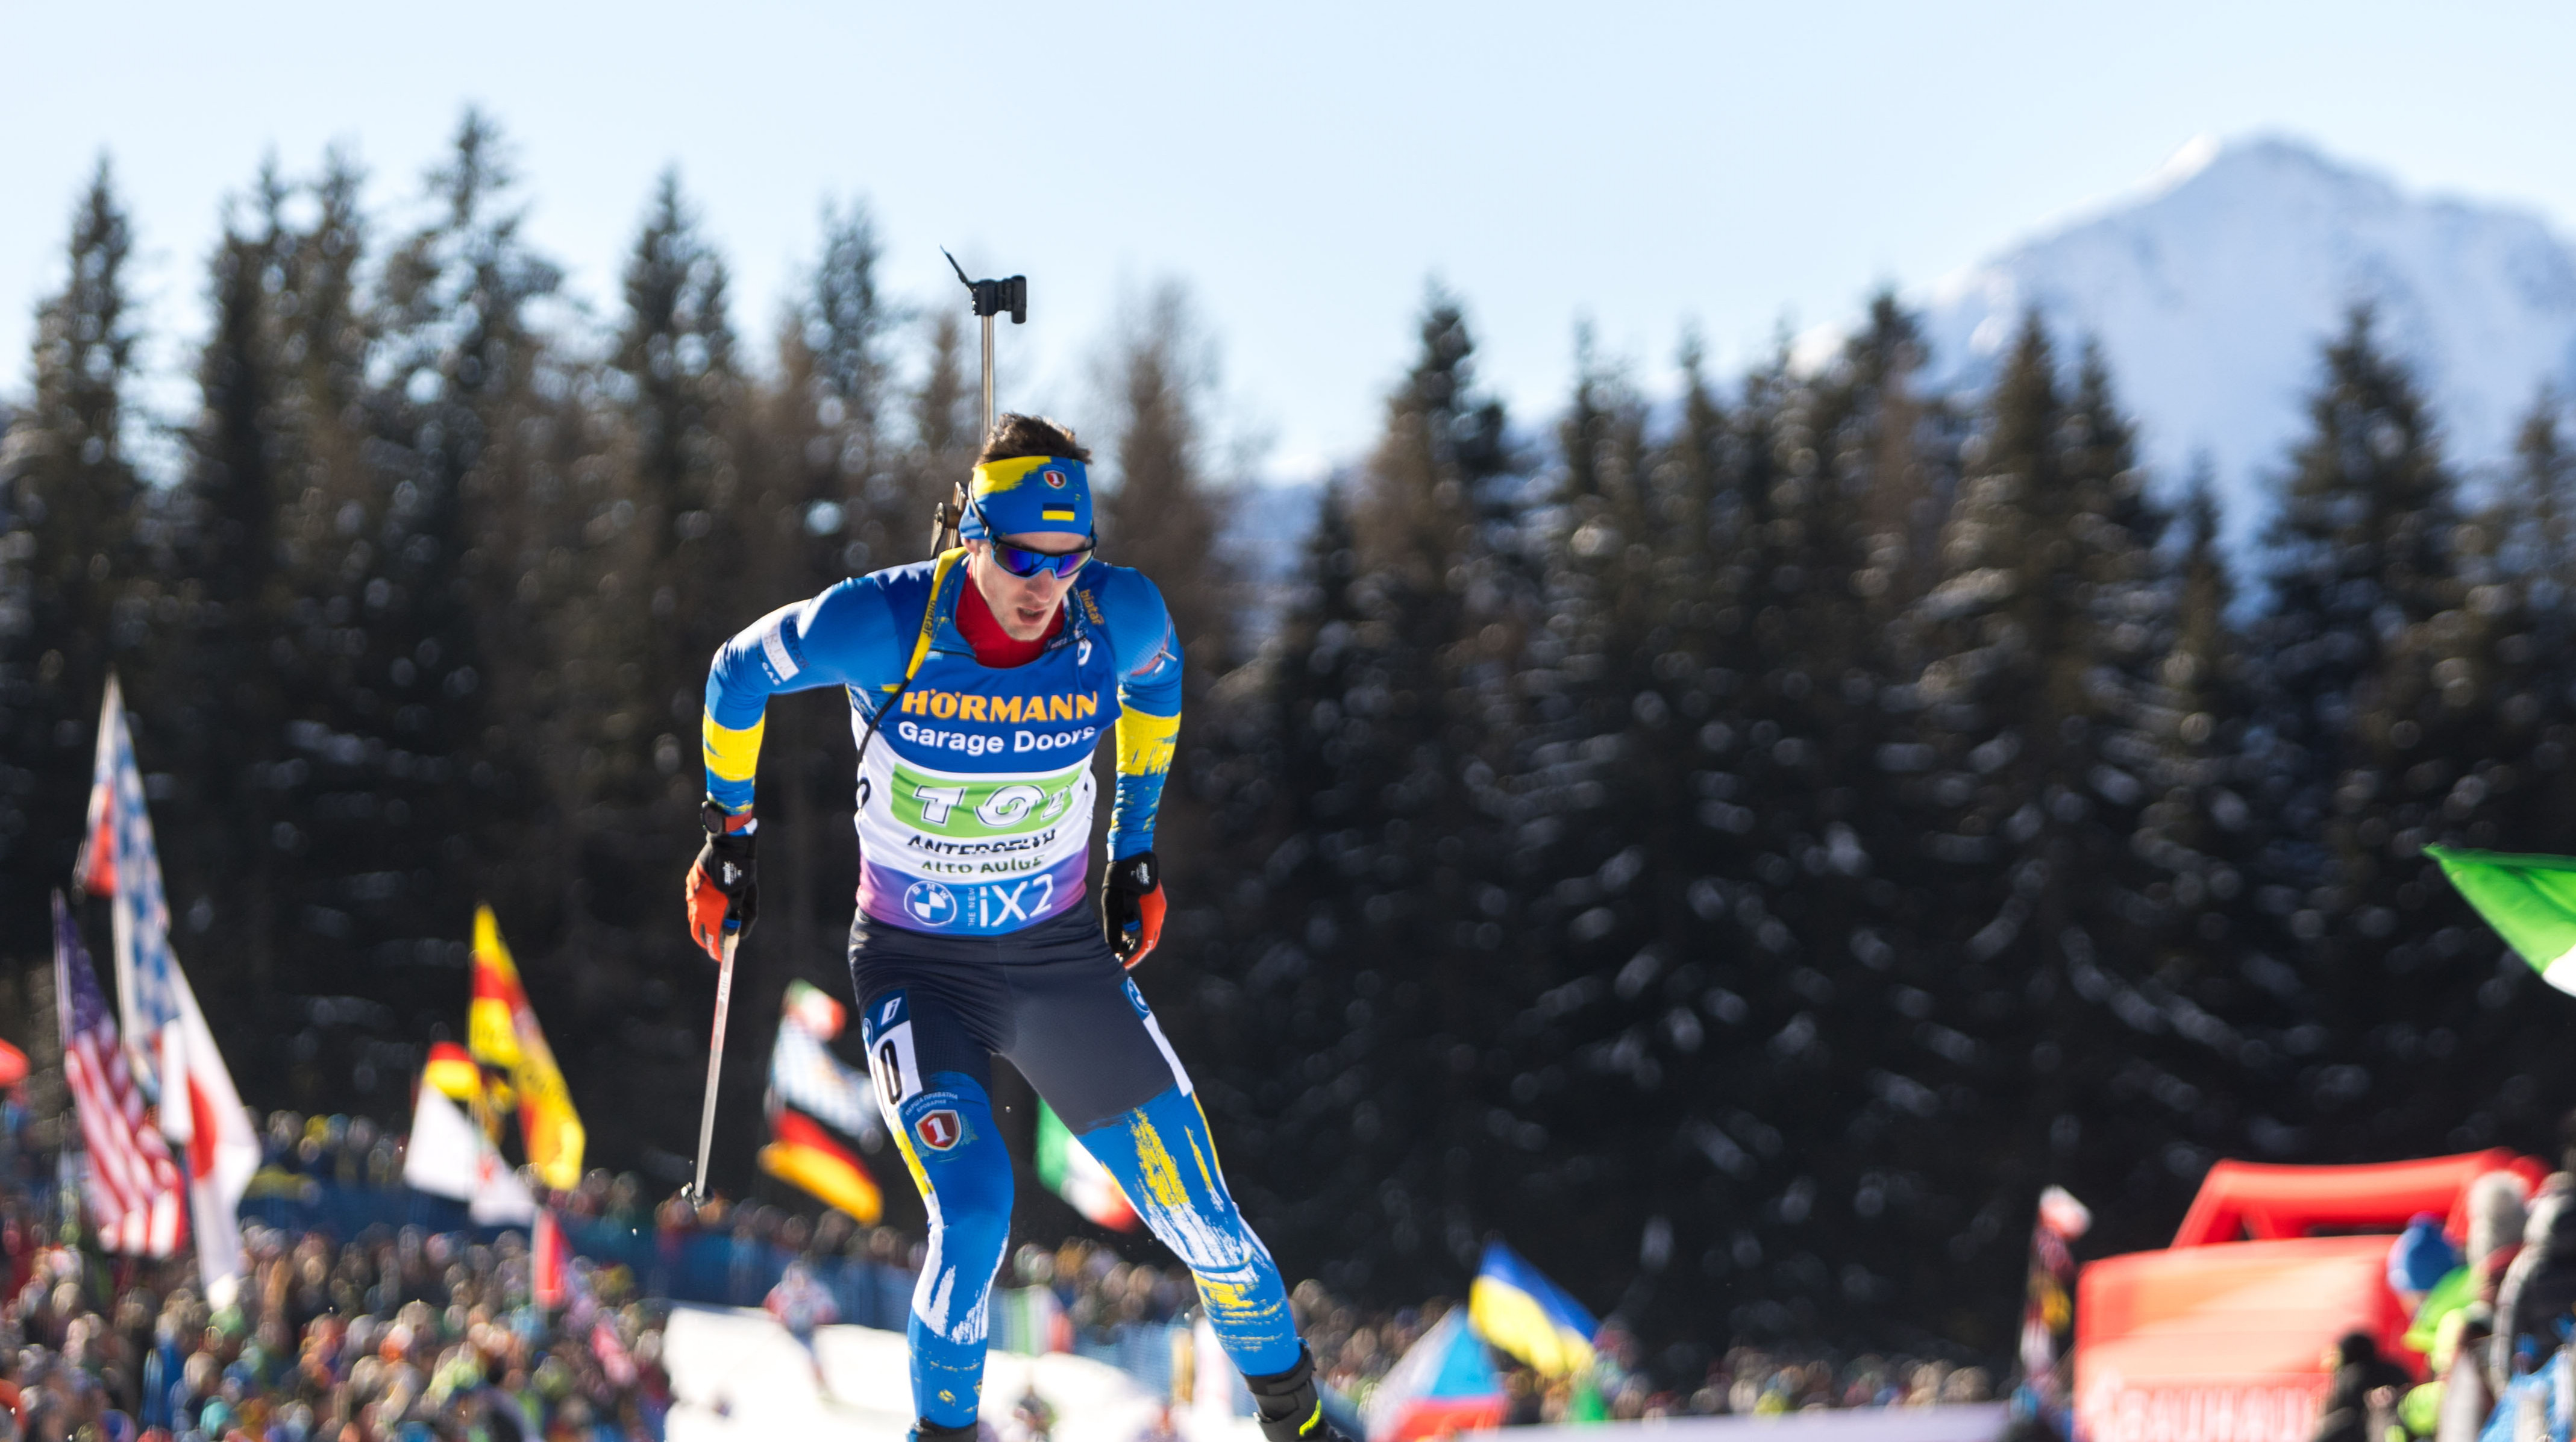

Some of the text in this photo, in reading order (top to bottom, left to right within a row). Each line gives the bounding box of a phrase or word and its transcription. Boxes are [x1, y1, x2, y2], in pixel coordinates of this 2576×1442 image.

[901, 689, 1097, 723] HÖRMANN
[898, 721, 1095, 756] Garage Doors
[912, 883, 949, 899] BMW
[968, 888, 976, 927] THE NEW
[980, 874, 1053, 928] iX2
[927, 1116, 952, 1144] 1
